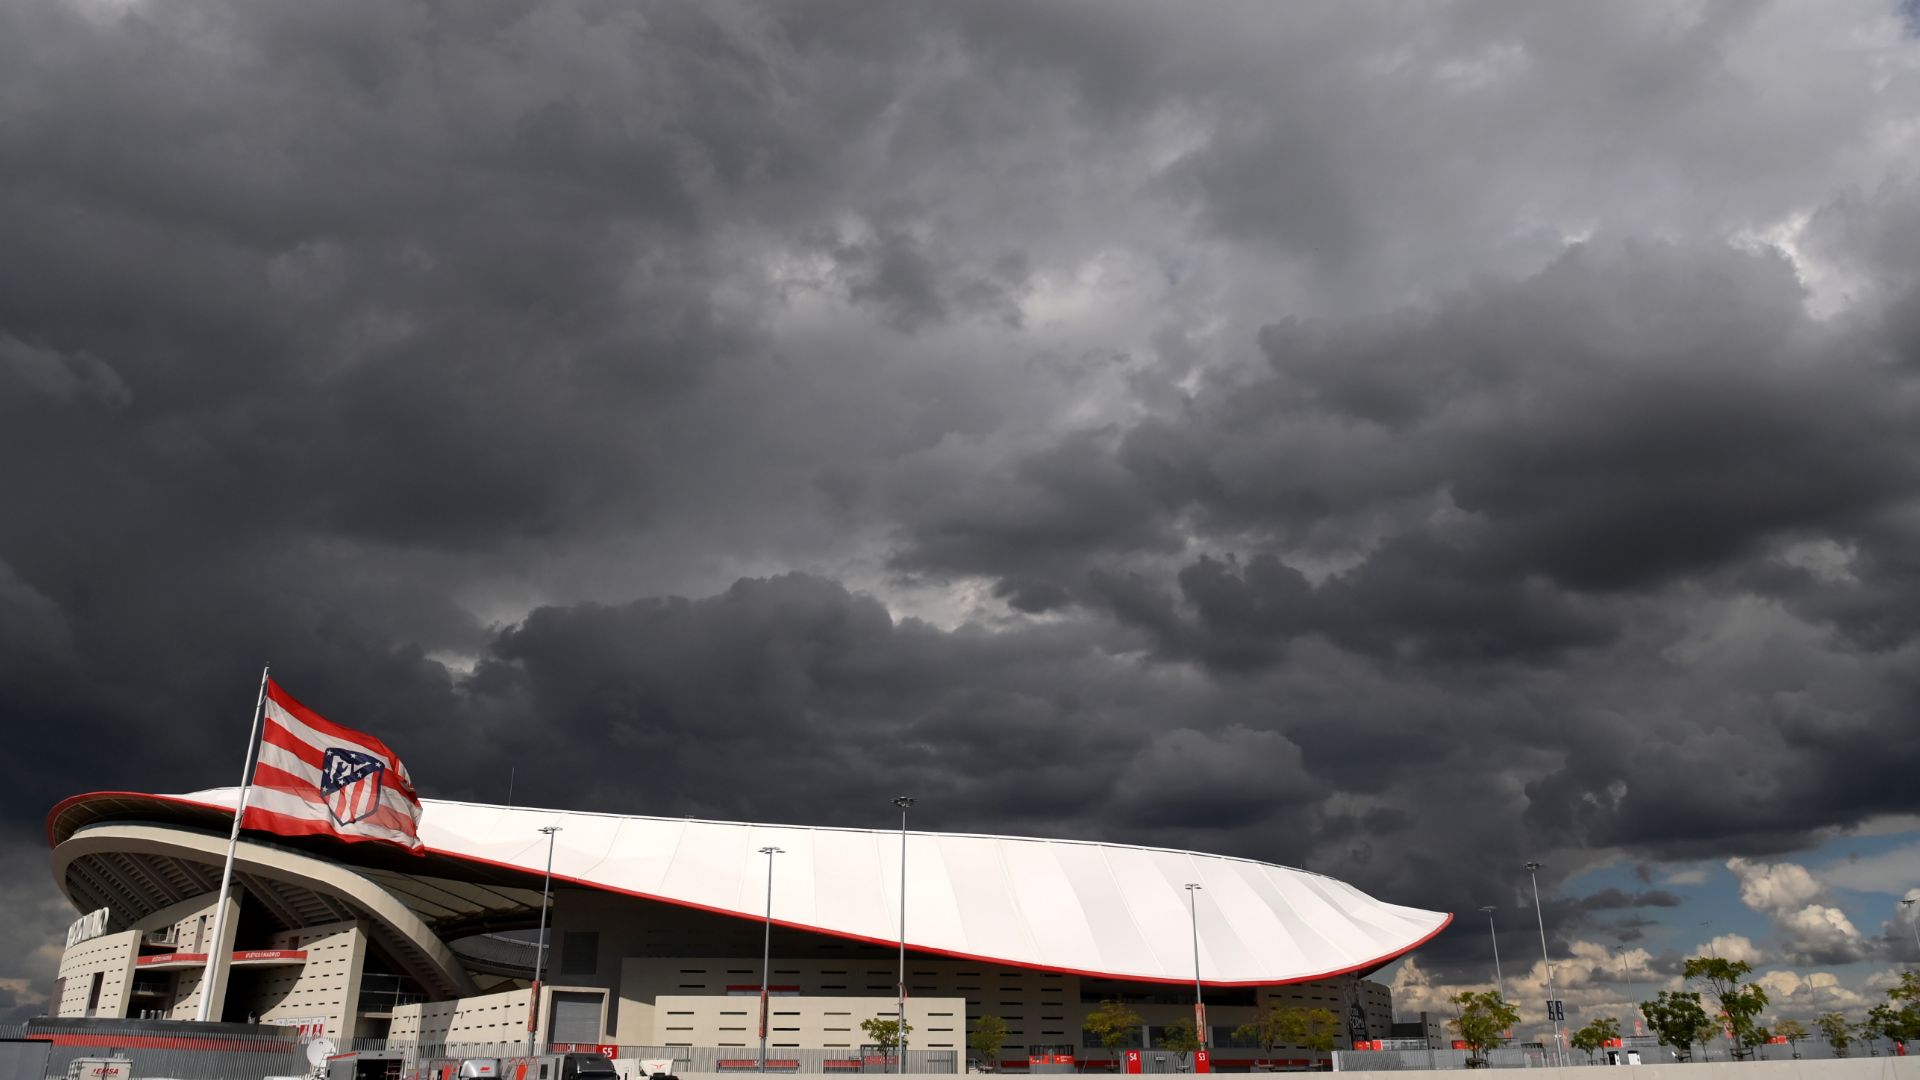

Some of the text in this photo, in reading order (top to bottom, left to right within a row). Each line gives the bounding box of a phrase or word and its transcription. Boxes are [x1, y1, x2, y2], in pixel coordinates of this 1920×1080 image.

[602, 1047, 613, 1058] S5
[1129, 1052, 1137, 1061] S4
[1198, 1052, 1206, 1061] S3
